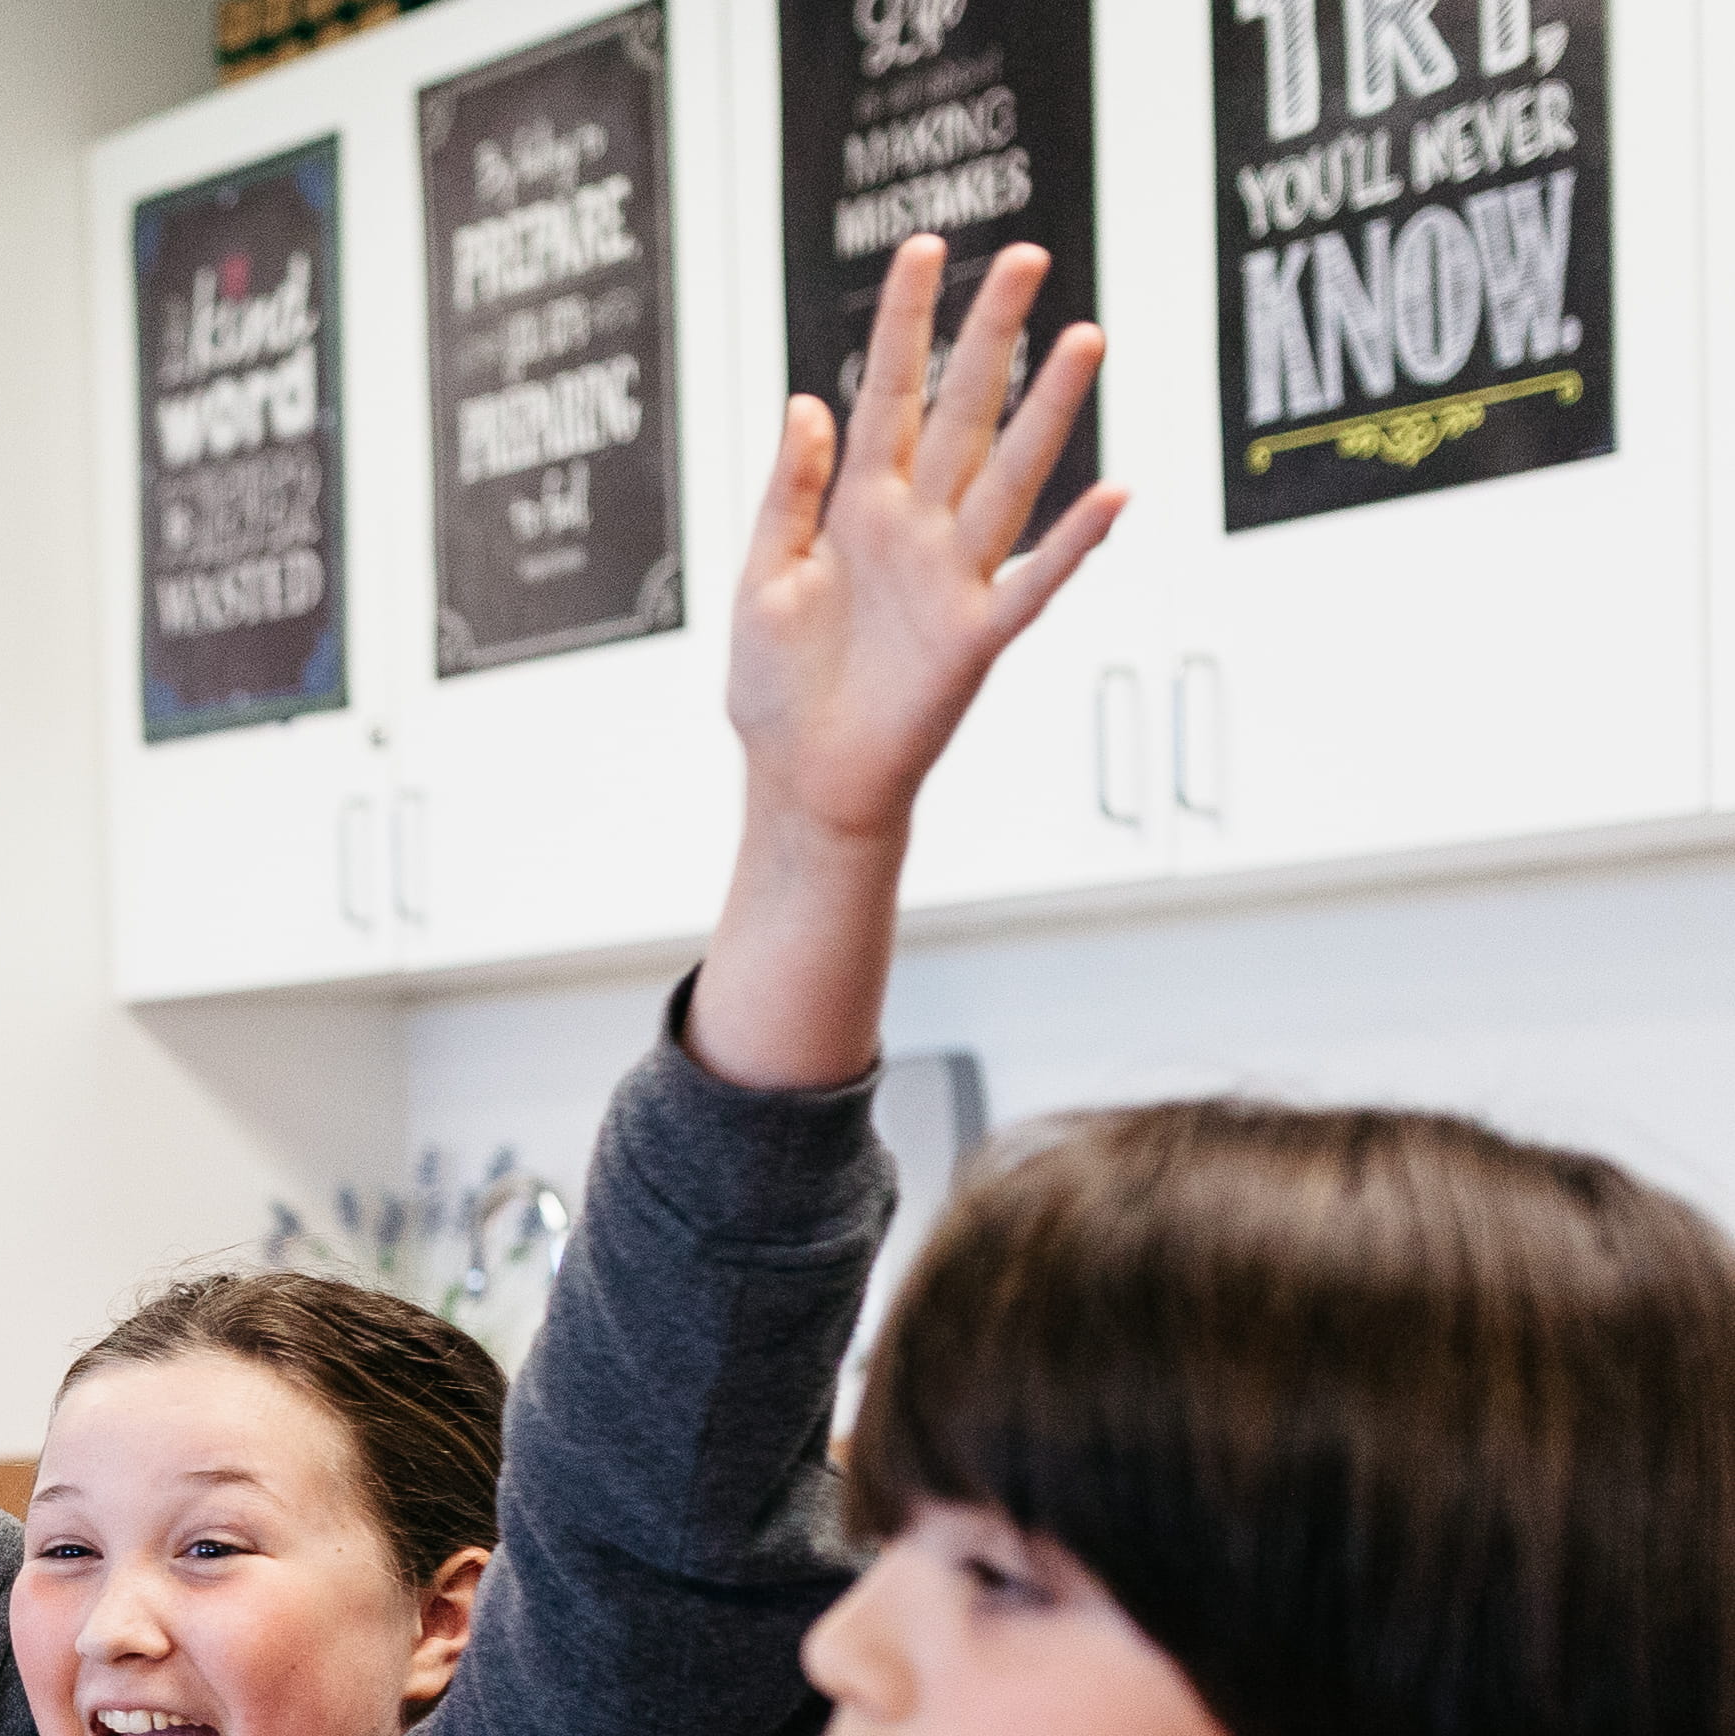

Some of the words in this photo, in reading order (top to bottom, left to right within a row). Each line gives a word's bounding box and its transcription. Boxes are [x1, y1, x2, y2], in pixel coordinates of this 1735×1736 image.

[842, 84, 1019, 196] MAKING
[1235, 126, 1405, 240] YOU'LL
[1409, 78, 1579, 194] NEVER
[833, 146, 1033, 262] MISTAKES
[1239, 166, 1584, 426] KNOW.
[157, 346, 319, 468] word
